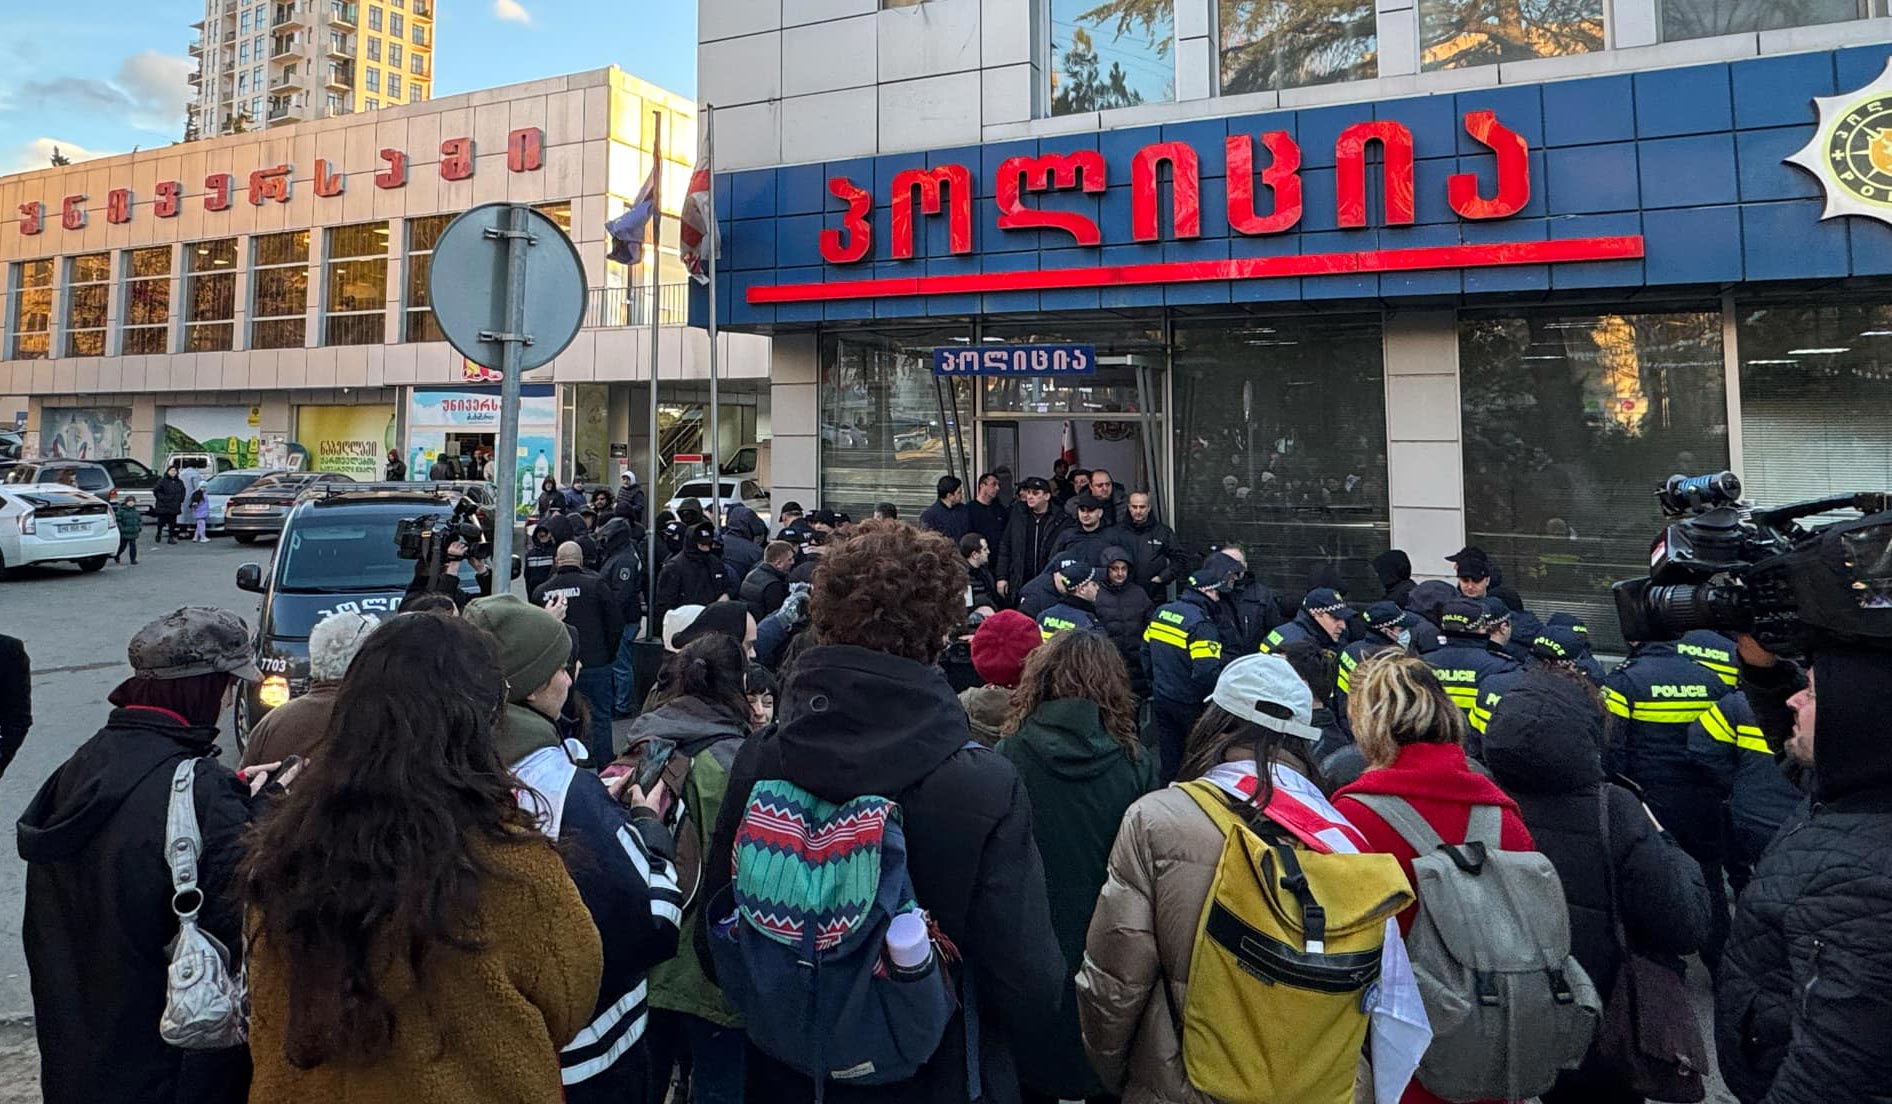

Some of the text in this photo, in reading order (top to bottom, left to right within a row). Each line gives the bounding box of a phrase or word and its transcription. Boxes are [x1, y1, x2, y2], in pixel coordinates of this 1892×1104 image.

[819, 109, 1530, 265] პოლიცია
[941, 348, 1087, 372] პოლიცია
[441, 398, 521, 412] უნივერს
[320, 440, 377, 457] ნაბეღლავი
[1534, 636, 1566, 656] POLICE
[1677, 643, 1730, 662] POLICE
[1651, 685, 1708, 698] POLICE
